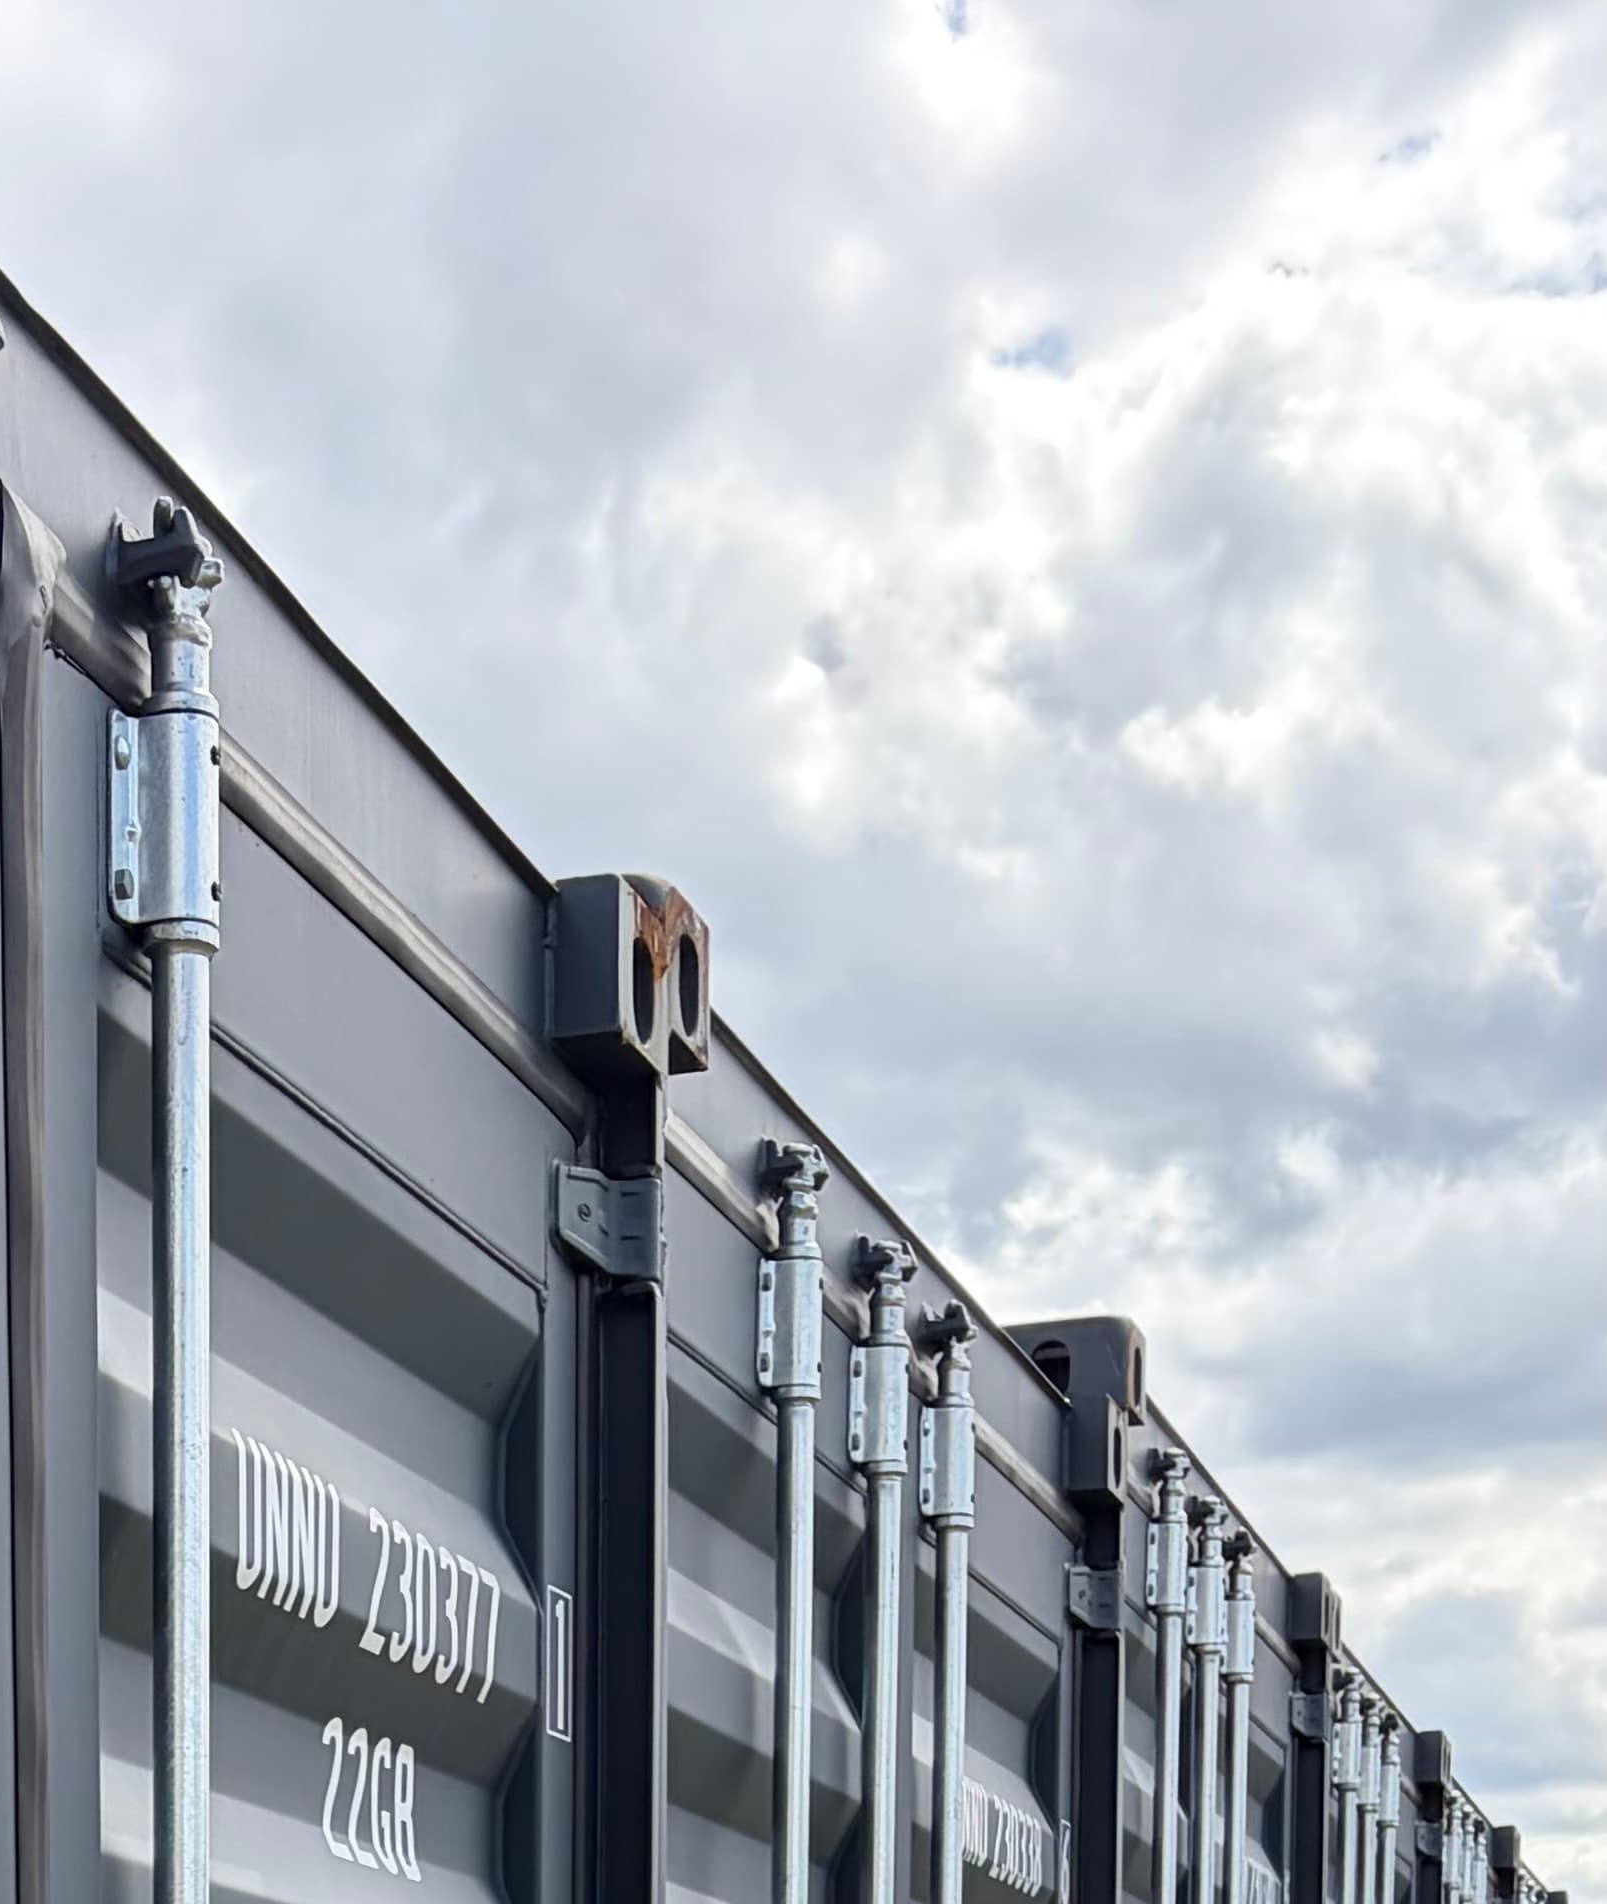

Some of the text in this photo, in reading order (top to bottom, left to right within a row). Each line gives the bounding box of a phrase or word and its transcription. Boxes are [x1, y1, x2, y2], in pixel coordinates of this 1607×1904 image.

[232, 1427, 565, 1730] UNNU 230377 1
[988, 1794, 1043, 1898] 230338
